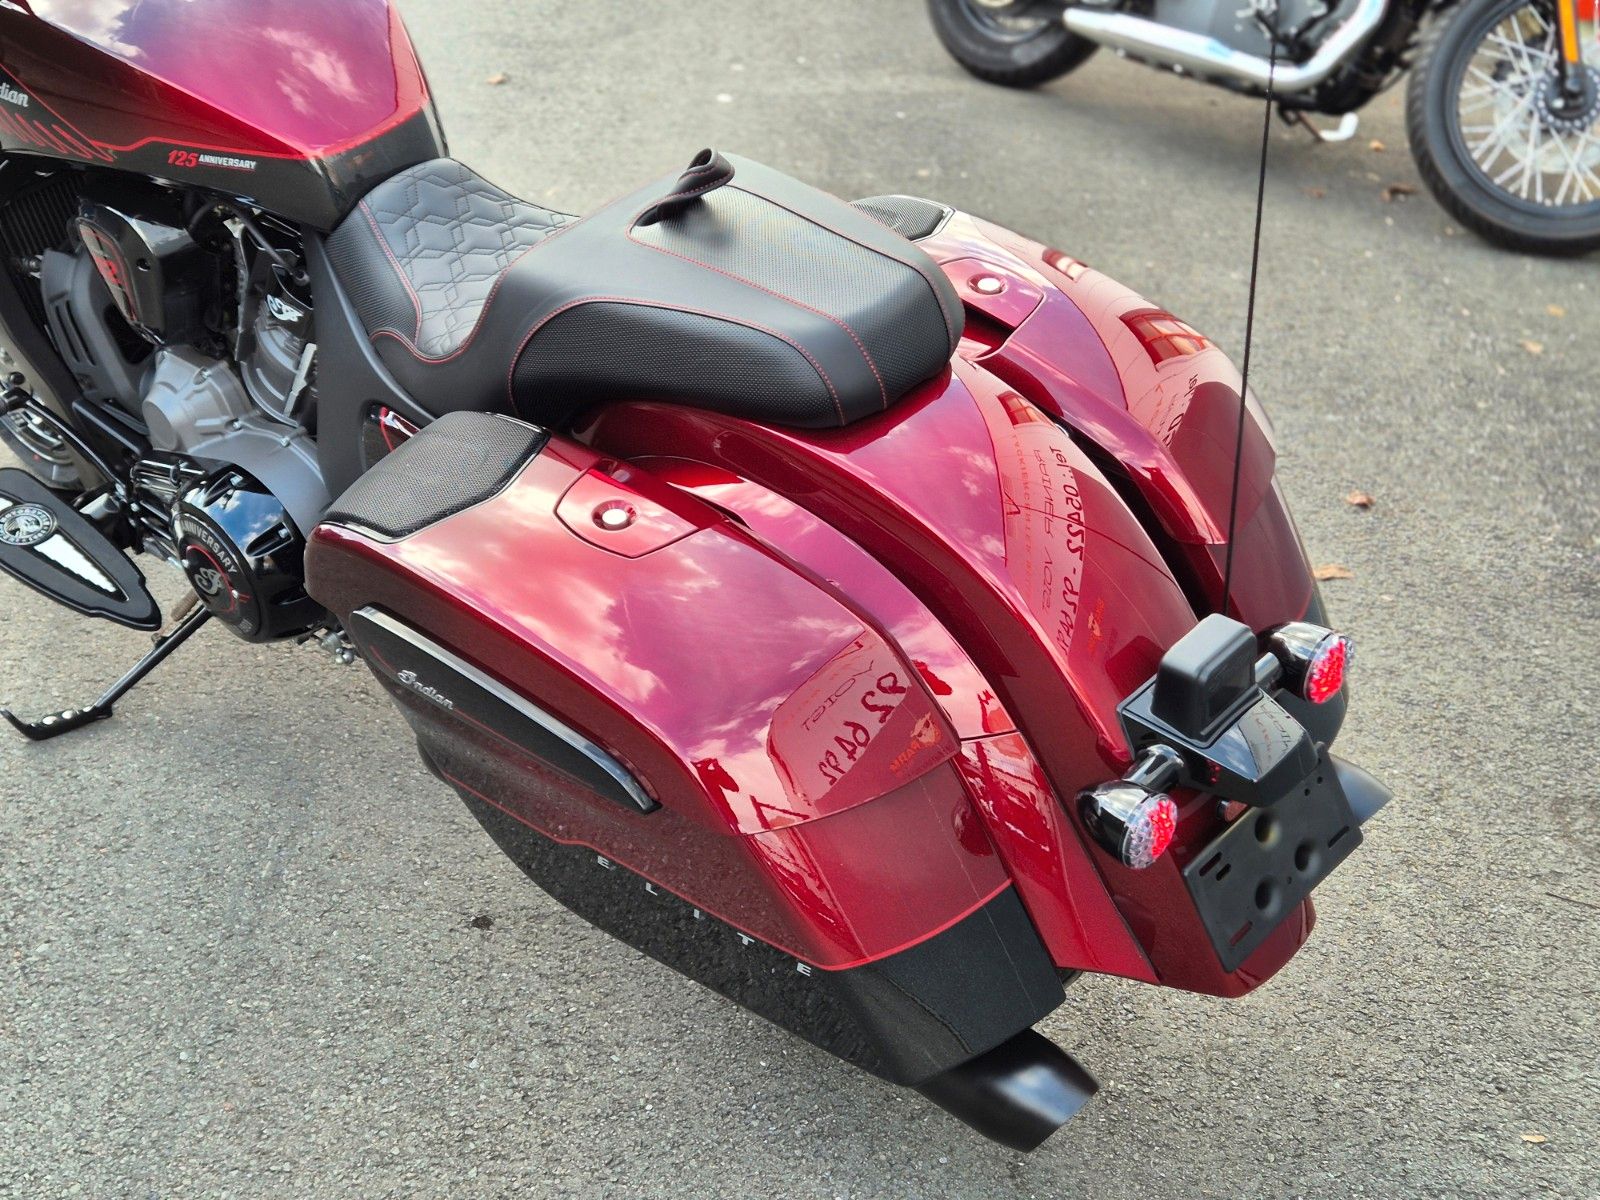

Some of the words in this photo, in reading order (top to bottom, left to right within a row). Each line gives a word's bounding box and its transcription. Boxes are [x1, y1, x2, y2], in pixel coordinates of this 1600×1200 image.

[167, 150, 199, 168] 125
[198, 154, 257, 170] ANNIVERSARY
[397, 669, 454, 711] Indian
[597, 855, 812, 977] ELITE
